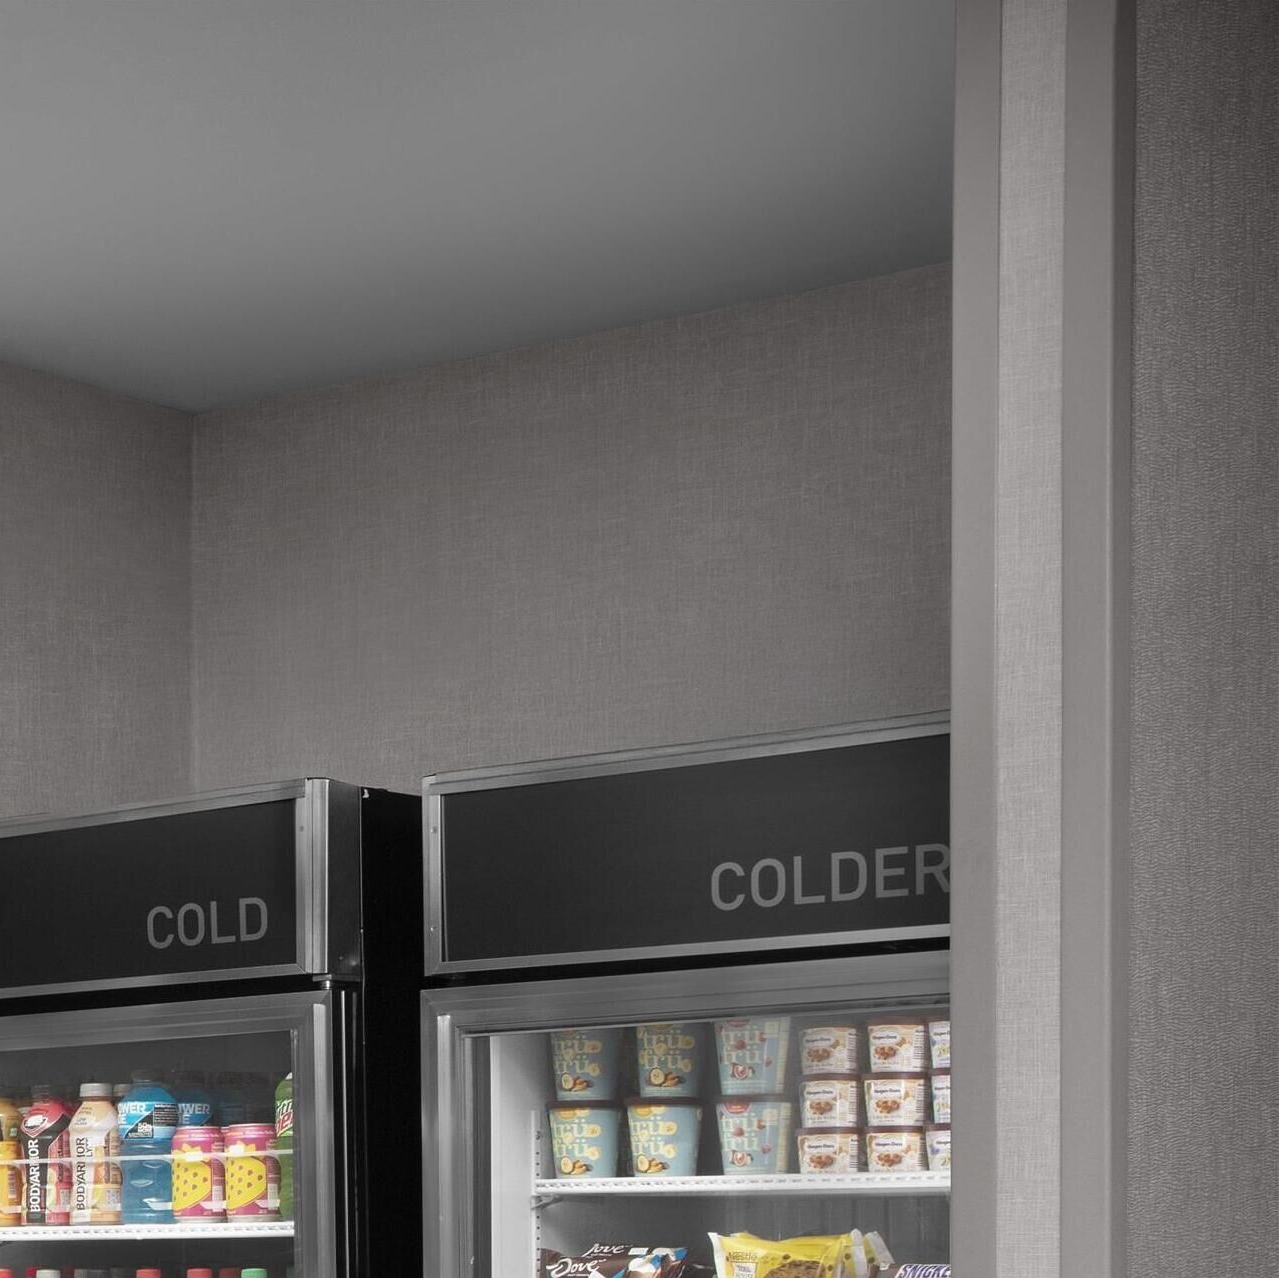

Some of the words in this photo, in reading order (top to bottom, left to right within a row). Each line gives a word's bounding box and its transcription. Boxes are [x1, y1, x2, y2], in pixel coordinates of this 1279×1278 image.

[710, 843, 951, 911] COLDER
[146, 897, 268, 949] COLD
[546, 1257, 600, 1278] Dove
